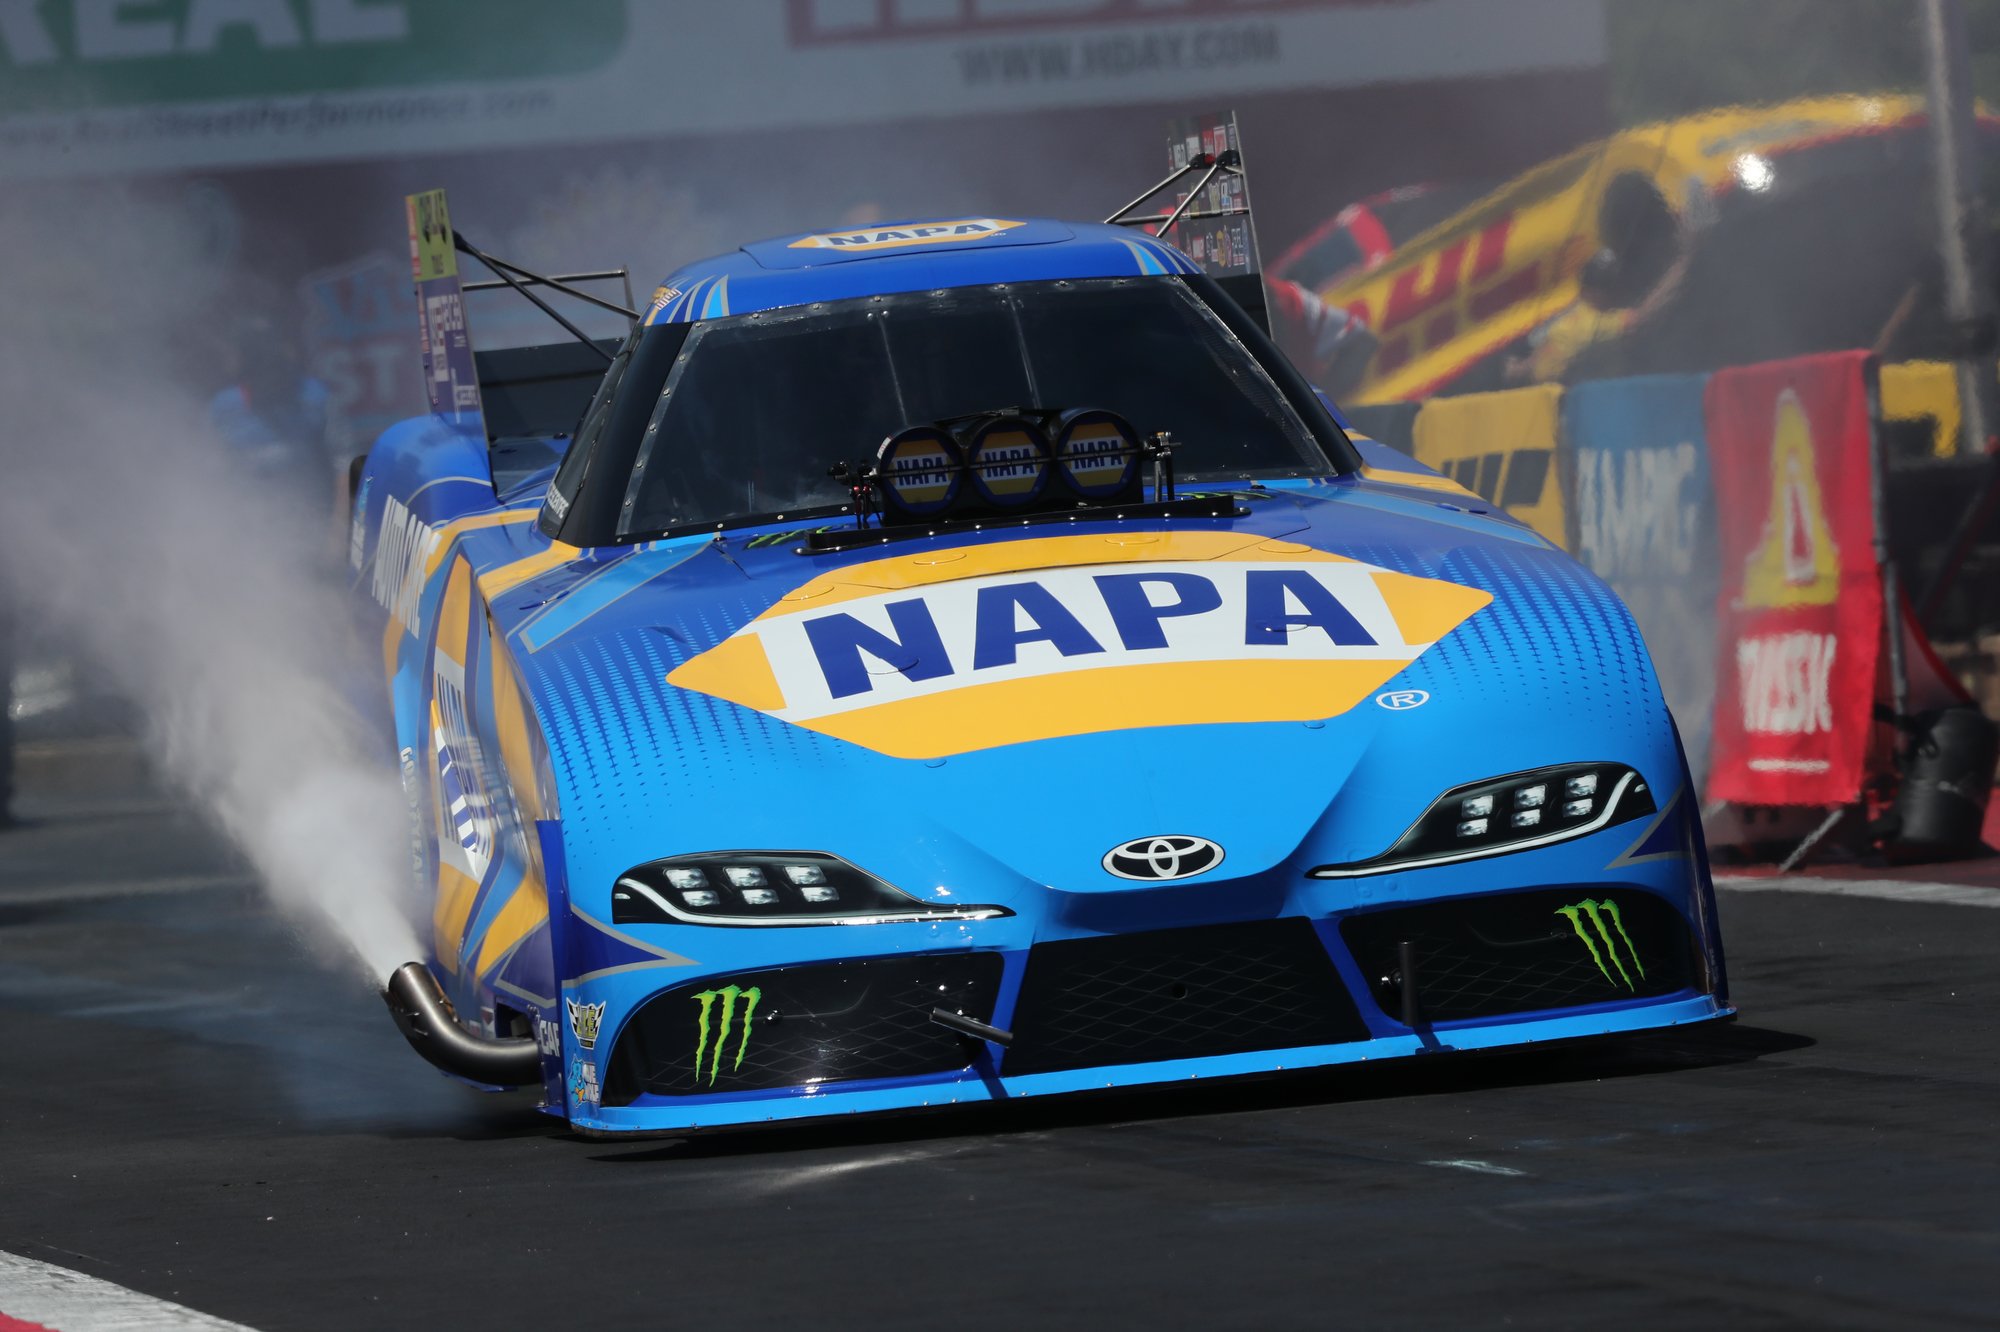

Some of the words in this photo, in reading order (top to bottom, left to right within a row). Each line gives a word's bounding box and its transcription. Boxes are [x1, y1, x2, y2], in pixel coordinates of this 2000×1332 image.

[828, 224, 993, 246] NAPA
[985, 447, 1035, 478] NAPA
[1072, 439, 1123, 470] NAPA
[896, 455, 947, 486] NAPA
[801, 569, 1379, 700] NAPA
